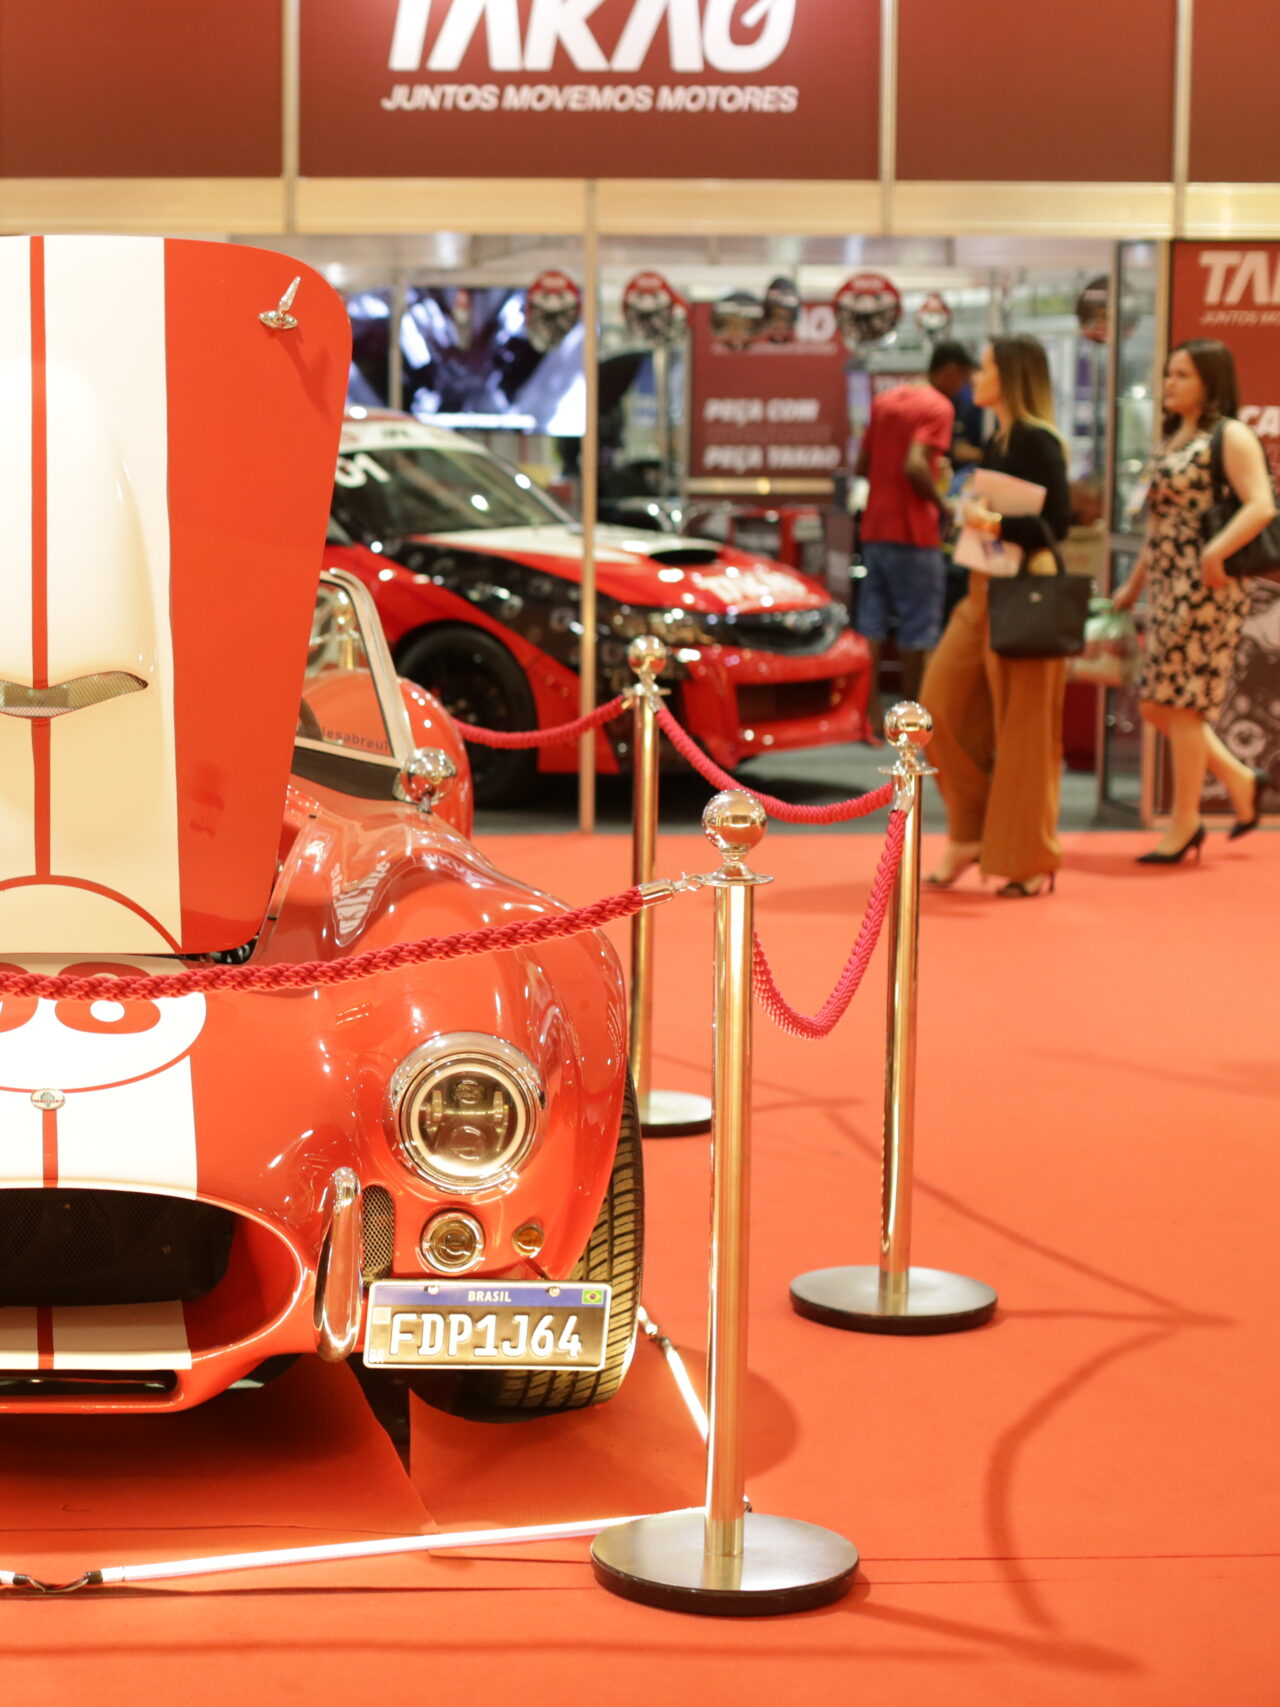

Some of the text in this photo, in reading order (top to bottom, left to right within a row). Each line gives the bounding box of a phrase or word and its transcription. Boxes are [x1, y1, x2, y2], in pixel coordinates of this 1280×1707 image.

[380, 84, 799, 113] JUNTOS MOVEMOS MOTORES
[1198, 250, 1280, 306] TA
[467, 1290, 512, 1303] BRASIL
[389, 1312, 582, 1358] FDP1J64
